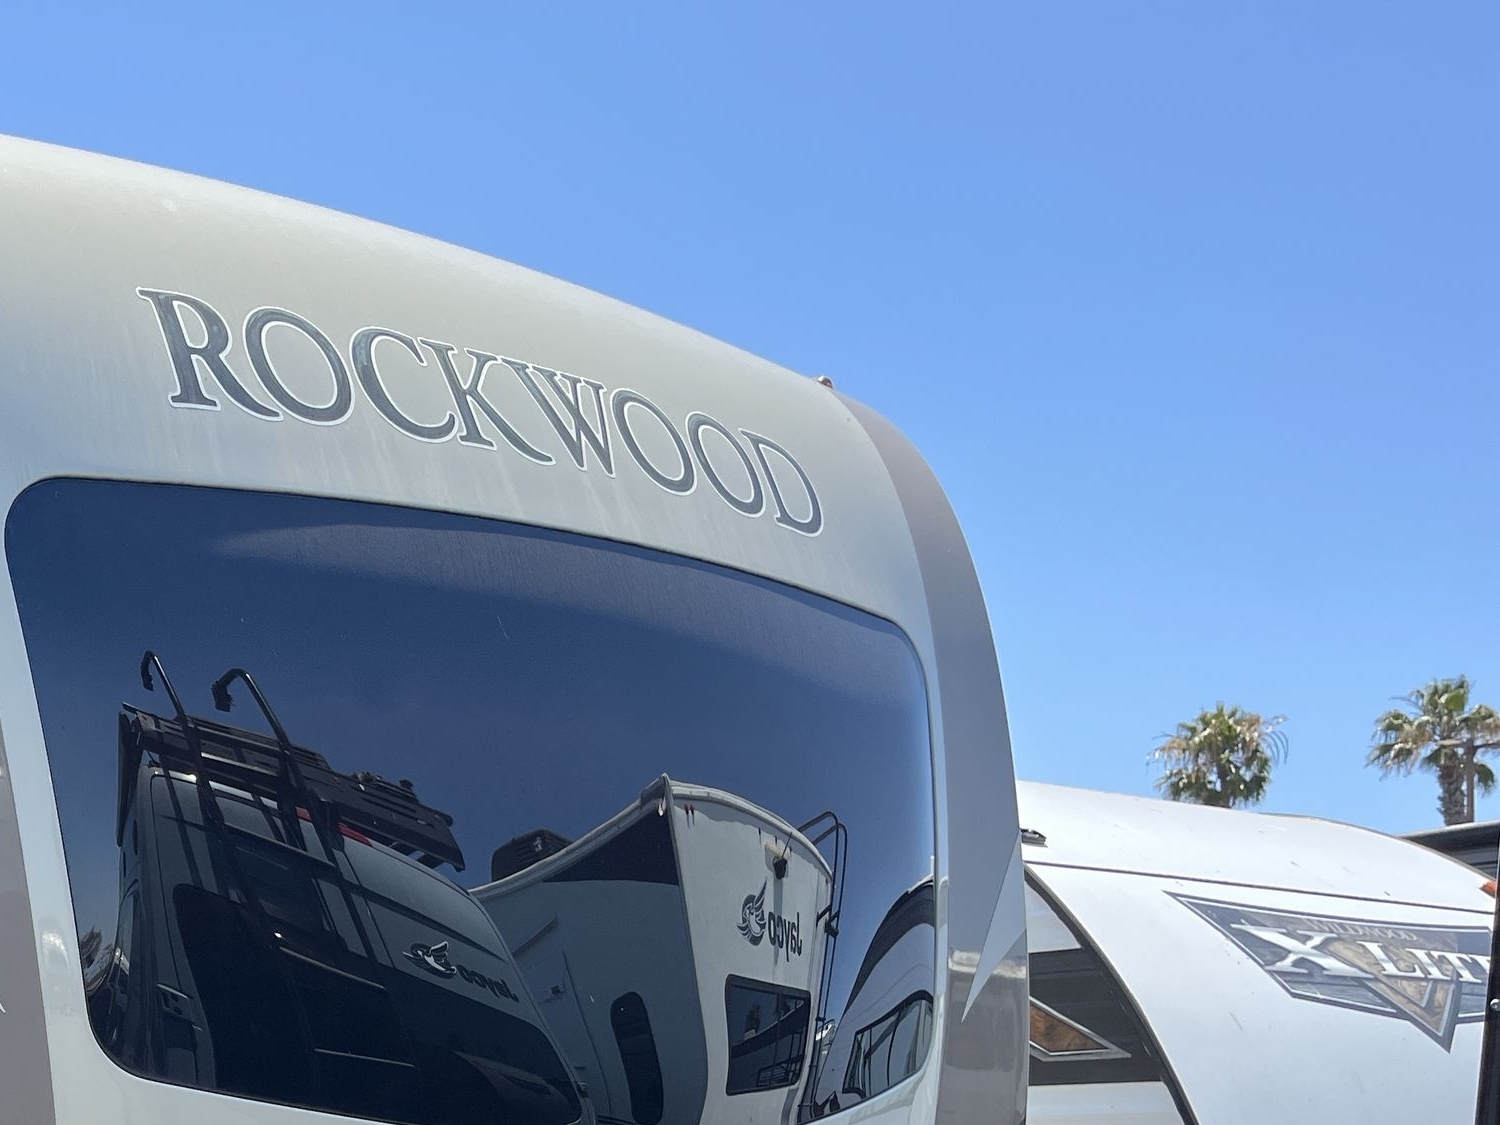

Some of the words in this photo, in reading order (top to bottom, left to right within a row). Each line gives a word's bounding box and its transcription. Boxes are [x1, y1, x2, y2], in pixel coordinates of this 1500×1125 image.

[136, 286, 825, 537] ROCKWOOD
[1230, 919, 1374, 979] X
[1306, 919, 1417, 940] WILDWOOD
